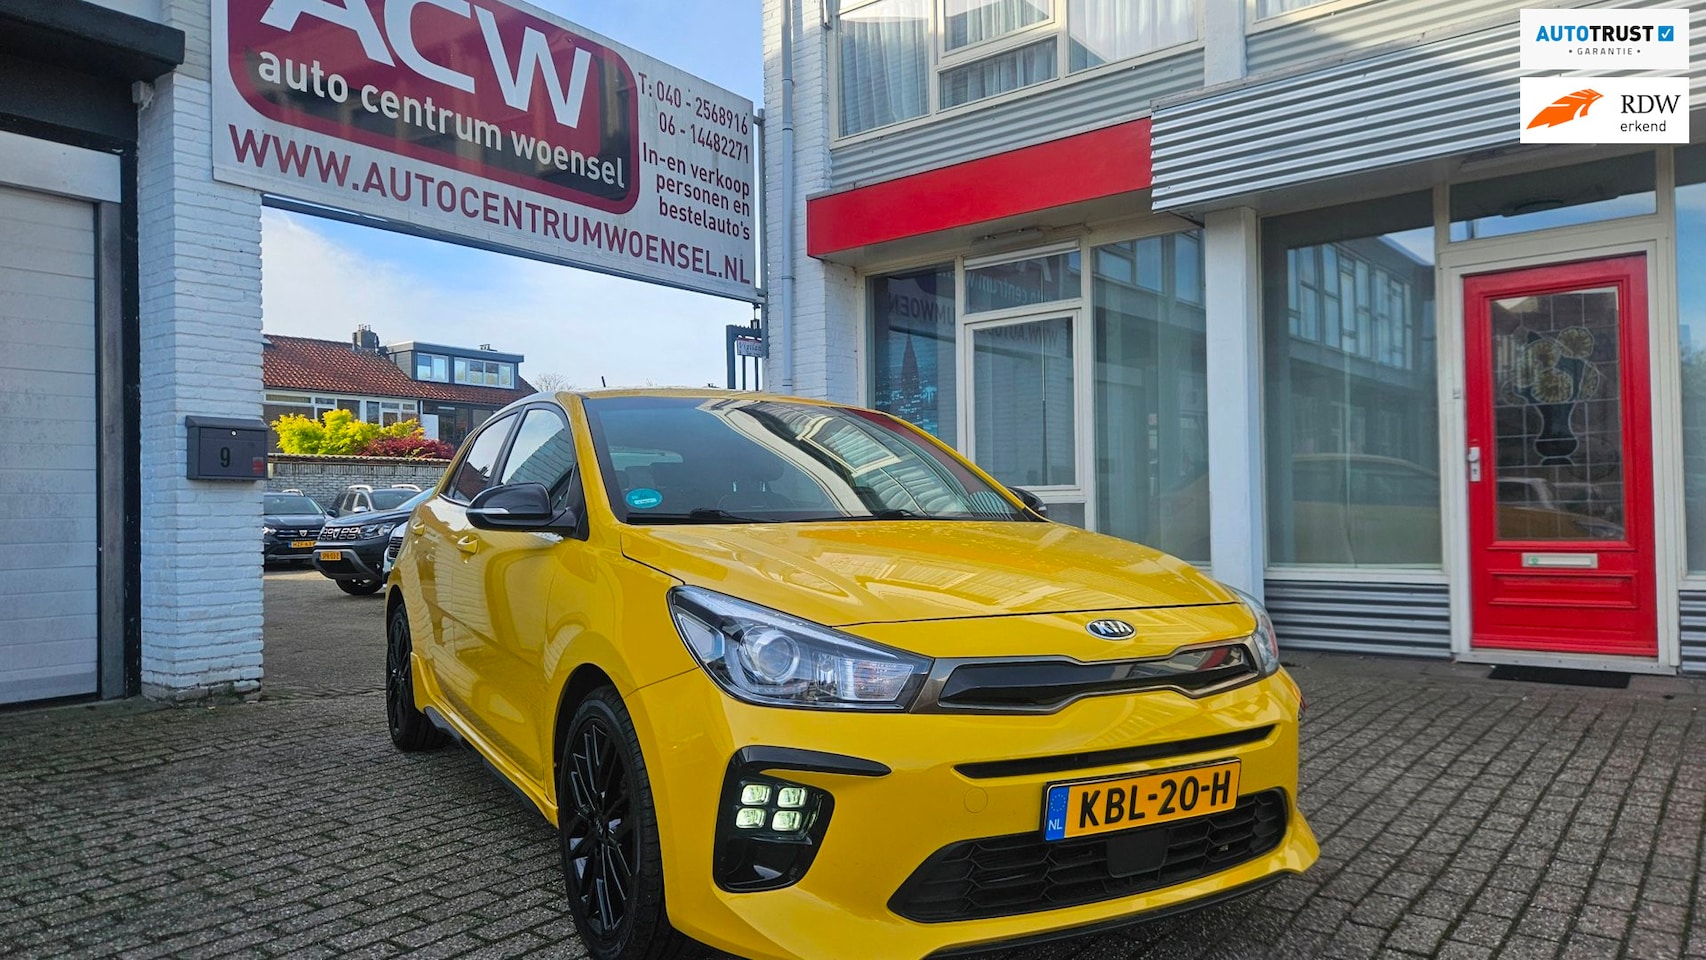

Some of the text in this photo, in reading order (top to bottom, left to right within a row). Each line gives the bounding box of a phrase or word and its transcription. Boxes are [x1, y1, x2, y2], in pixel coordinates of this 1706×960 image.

[258, 51, 625, 189] auto centrum woensel
[638, 72, 653, 98] T:
[657, 80, 681, 108] 040
[695, 96, 748, 135] 2568916
[659, 111, 675, 136] 06
[690, 123, 749, 164] 14482271
[643, 141, 750, 200] In-en verkoop
[656, 173, 750, 217] personen en
[228, 124, 750, 285] WWW.AUTOCENTRUMWOENSEL.NL
[659, 195, 750, 241] bestelauto's
[219, 446, 231, 468] 9
[1093, 620, 1133, 634] KIA
[1048, 770, 1231, 831] NL KBL-20-H
